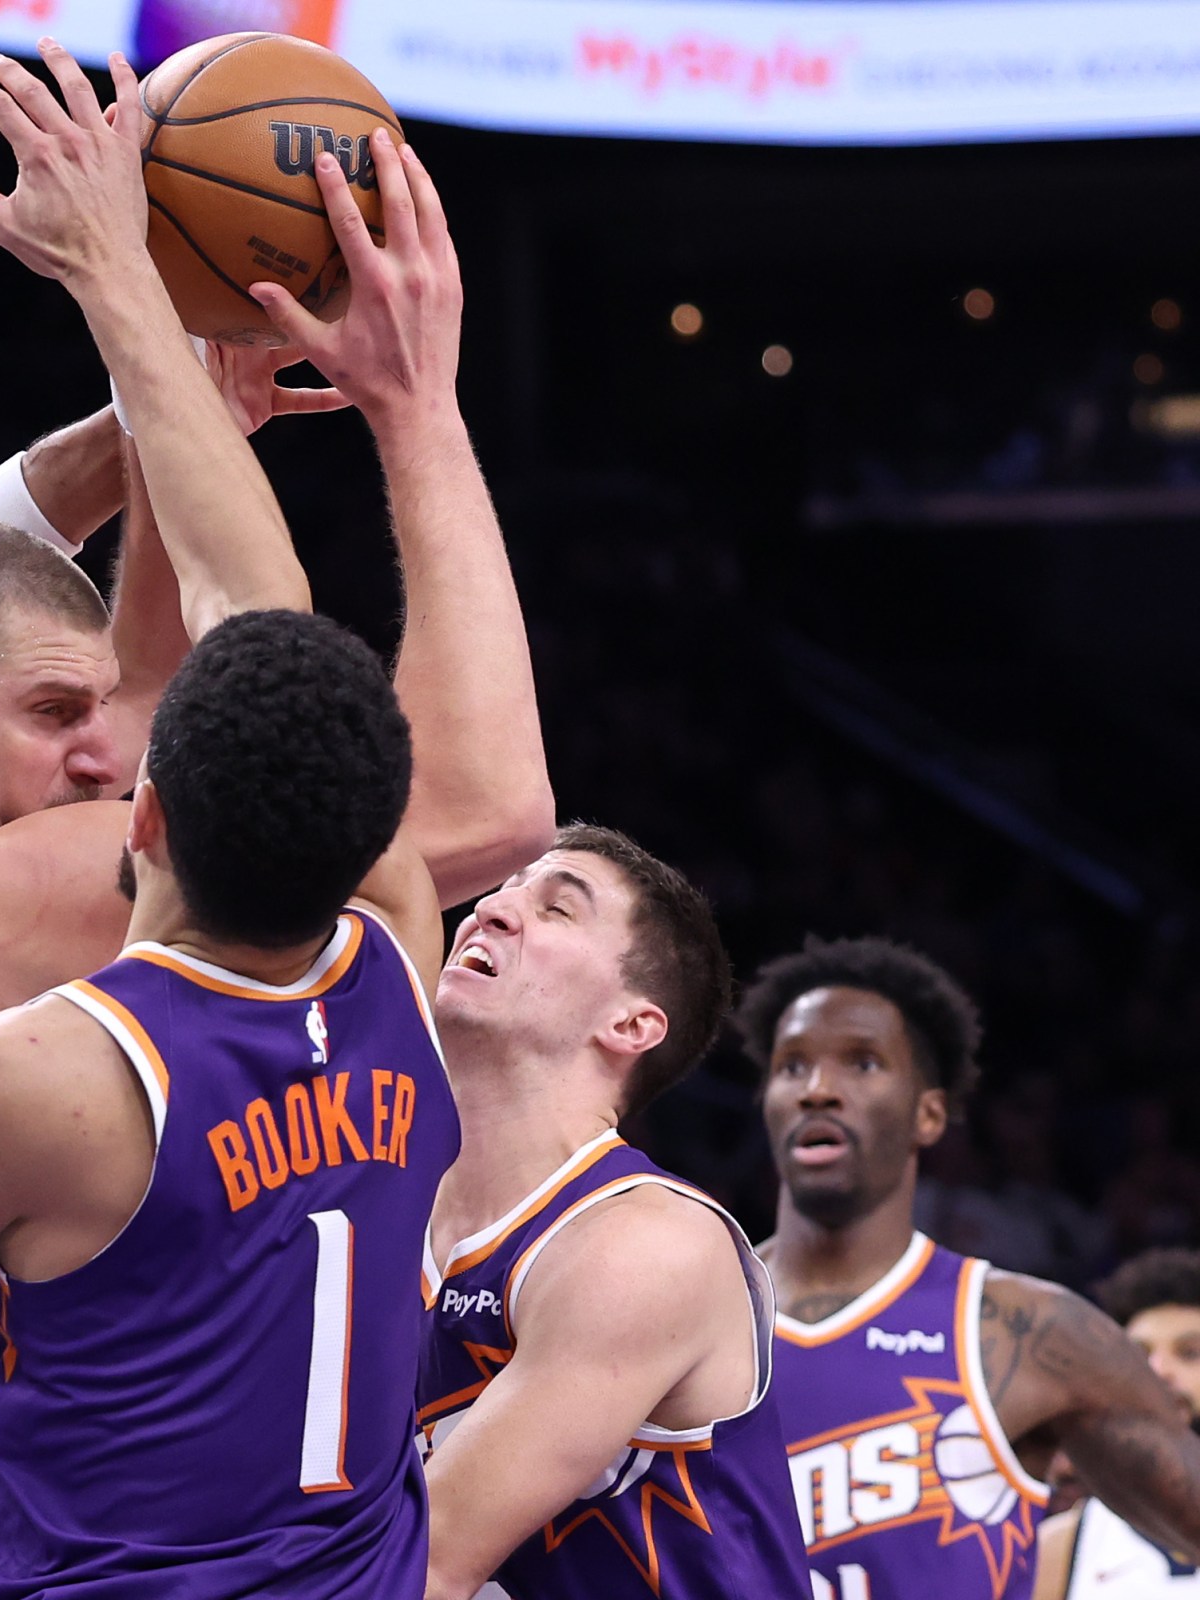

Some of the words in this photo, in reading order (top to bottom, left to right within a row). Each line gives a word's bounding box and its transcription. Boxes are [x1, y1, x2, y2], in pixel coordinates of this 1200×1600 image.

[269, 121, 377, 190] Wil
[207, 1068, 416, 1213] BOOKER
[441, 1288, 502, 1318] PayPa
[299, 1209, 355, 1494] 1
[866, 1326, 945, 1357] PayPal
